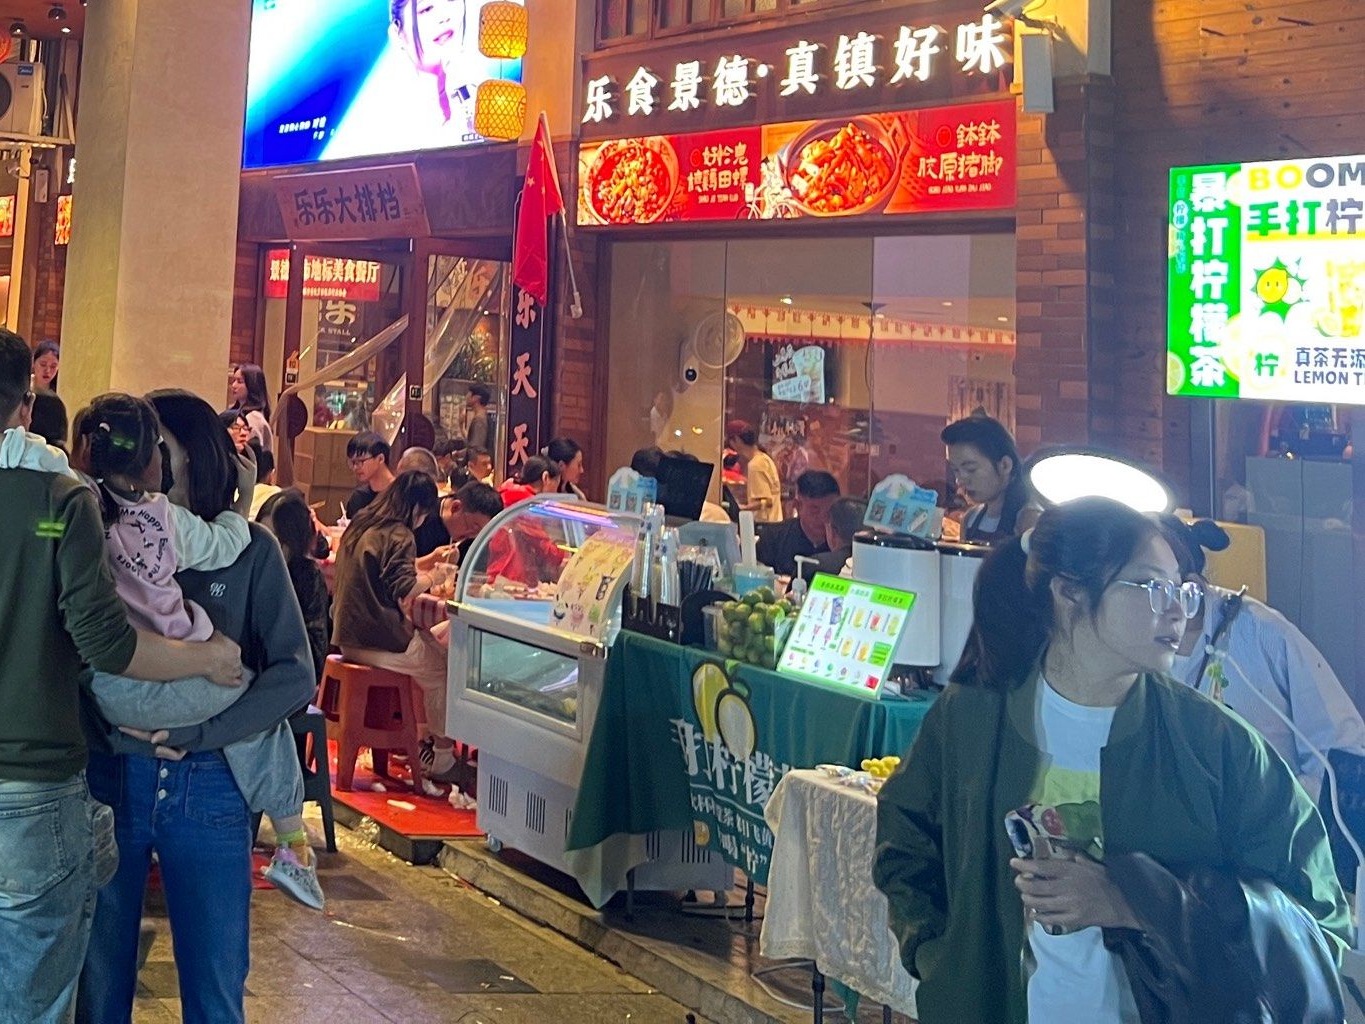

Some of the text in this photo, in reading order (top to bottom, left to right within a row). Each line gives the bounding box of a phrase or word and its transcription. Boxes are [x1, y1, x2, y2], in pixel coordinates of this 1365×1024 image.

[917, 149, 1004, 182] 胶原猪脚
[293, 182, 401, 226] 乐乐大排档
[1247, 198, 1364, 236] 手打柠
[1294, 370, 1349, 385] LEMON
